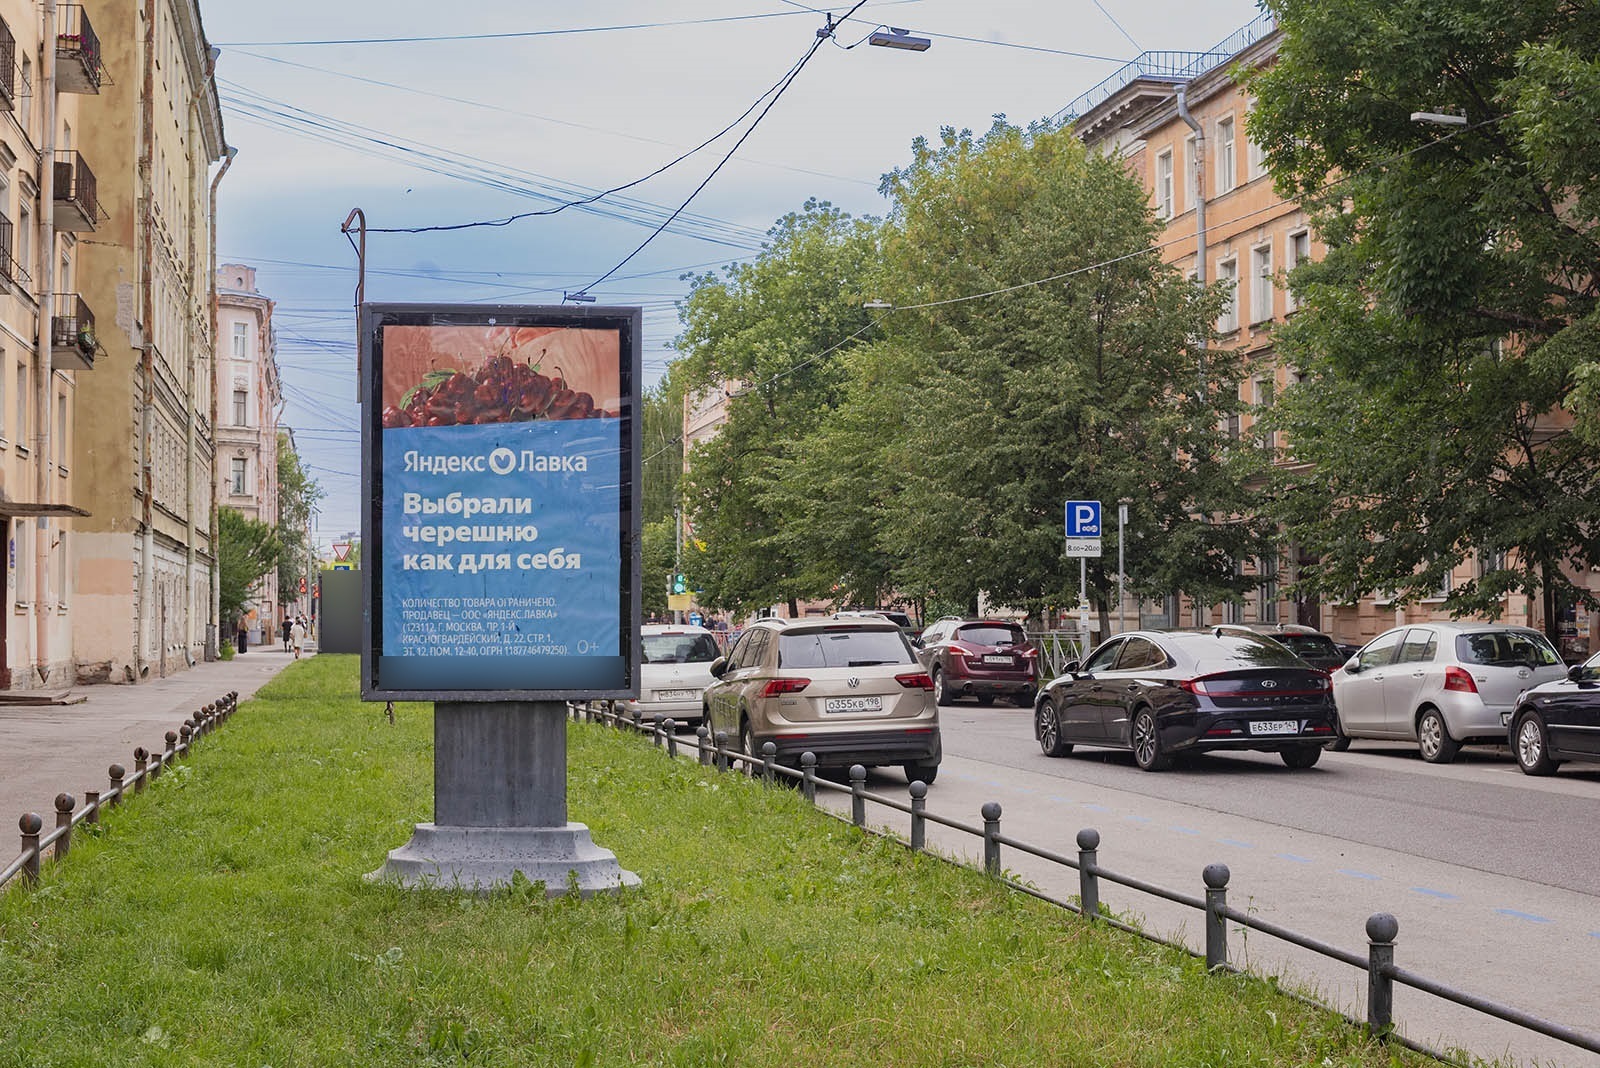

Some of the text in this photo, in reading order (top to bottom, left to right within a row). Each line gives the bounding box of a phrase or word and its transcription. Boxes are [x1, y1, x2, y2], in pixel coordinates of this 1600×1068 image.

[404, 451, 587, 475] Яндекс Лавка
[403, 492, 532, 518] Выбрали
[1075, 505, 1095, 533] P
[403, 525, 538, 546] черешню
[403, 548, 581, 574] как для себя
[402, 597, 557, 608] КОЛИЧЕСТВО ТОВАРА ОГРАНИЧЕНО.
[402, 610, 450, 621] ПРОДАВЕЦ
[461, 610, 481, 620] ООО
[480, 646, 502, 656] ОГРН
[577, 640, 599, 654] 0+
